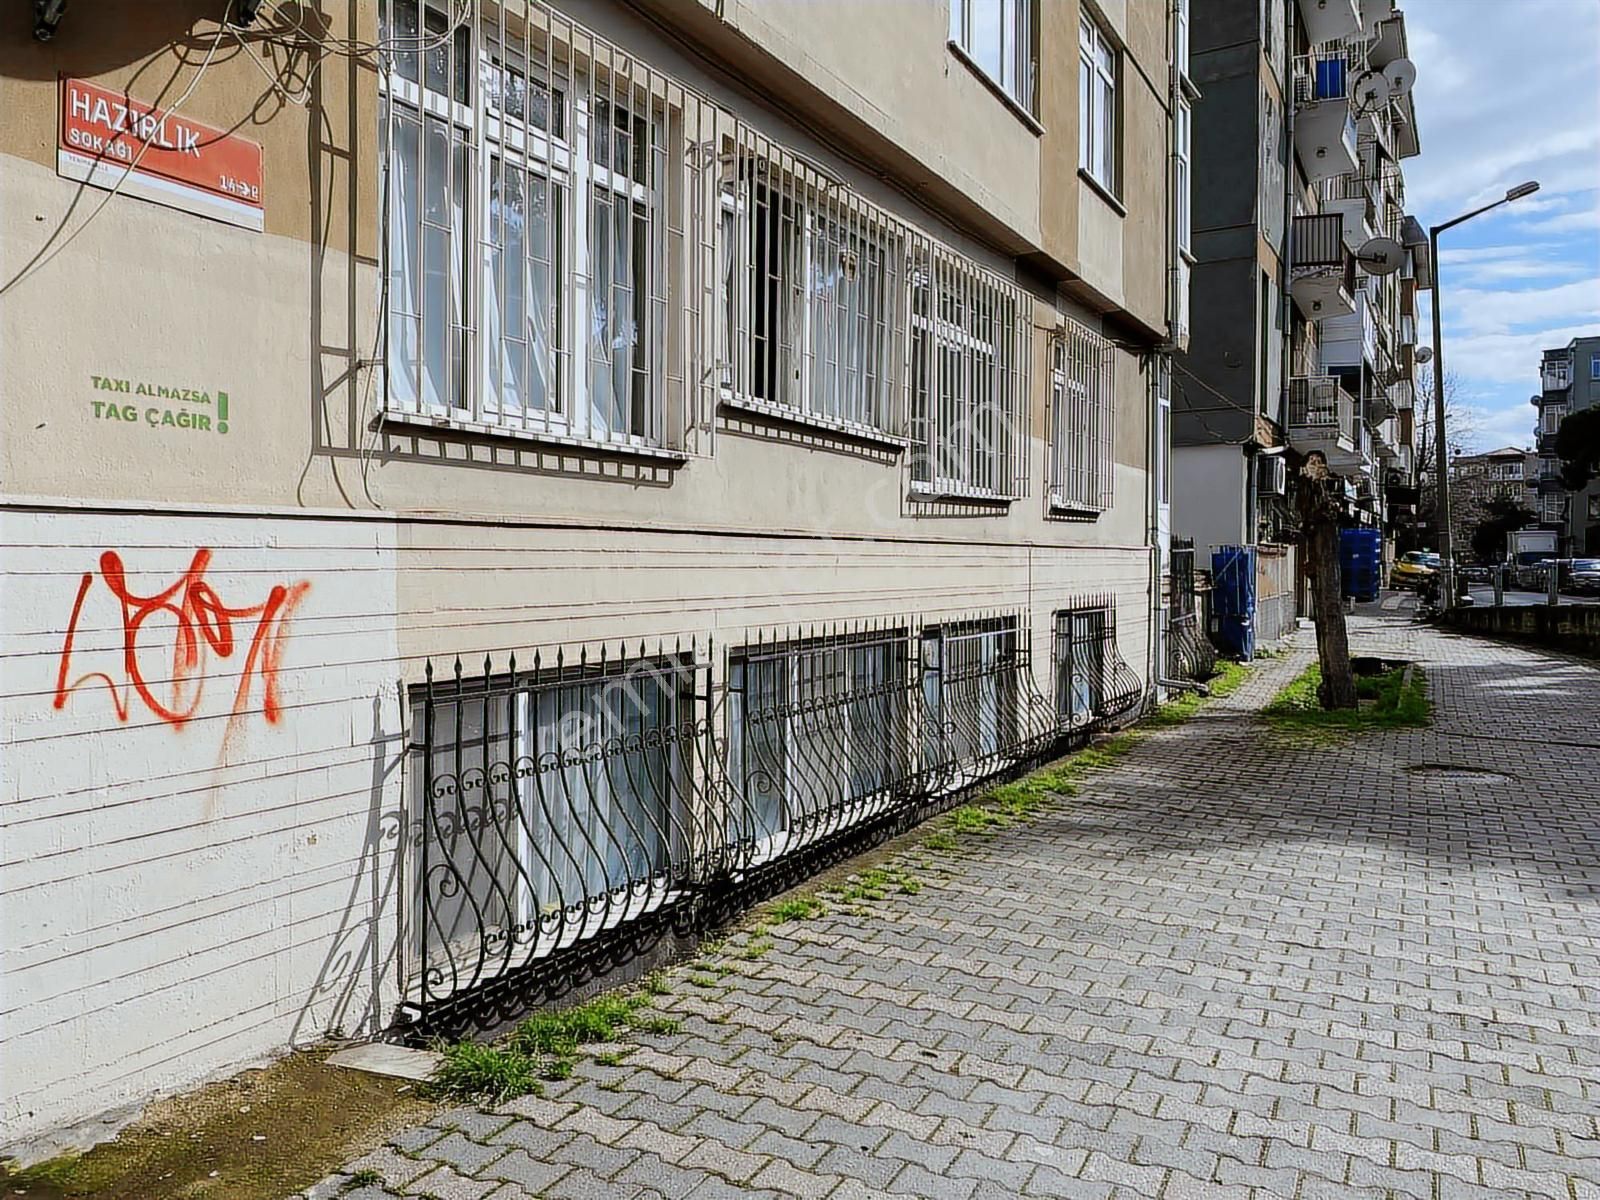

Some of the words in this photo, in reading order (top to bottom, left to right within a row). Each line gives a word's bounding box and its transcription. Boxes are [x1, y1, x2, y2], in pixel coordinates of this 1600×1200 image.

[71, 88, 200, 158] HAZIRLIK
[69, 127, 133, 160] SOKAĞI
[90, 375, 130, 393] TAXI
[135, 382, 211, 404] ALMAZSA
[90, 401, 138, 422] TAG
